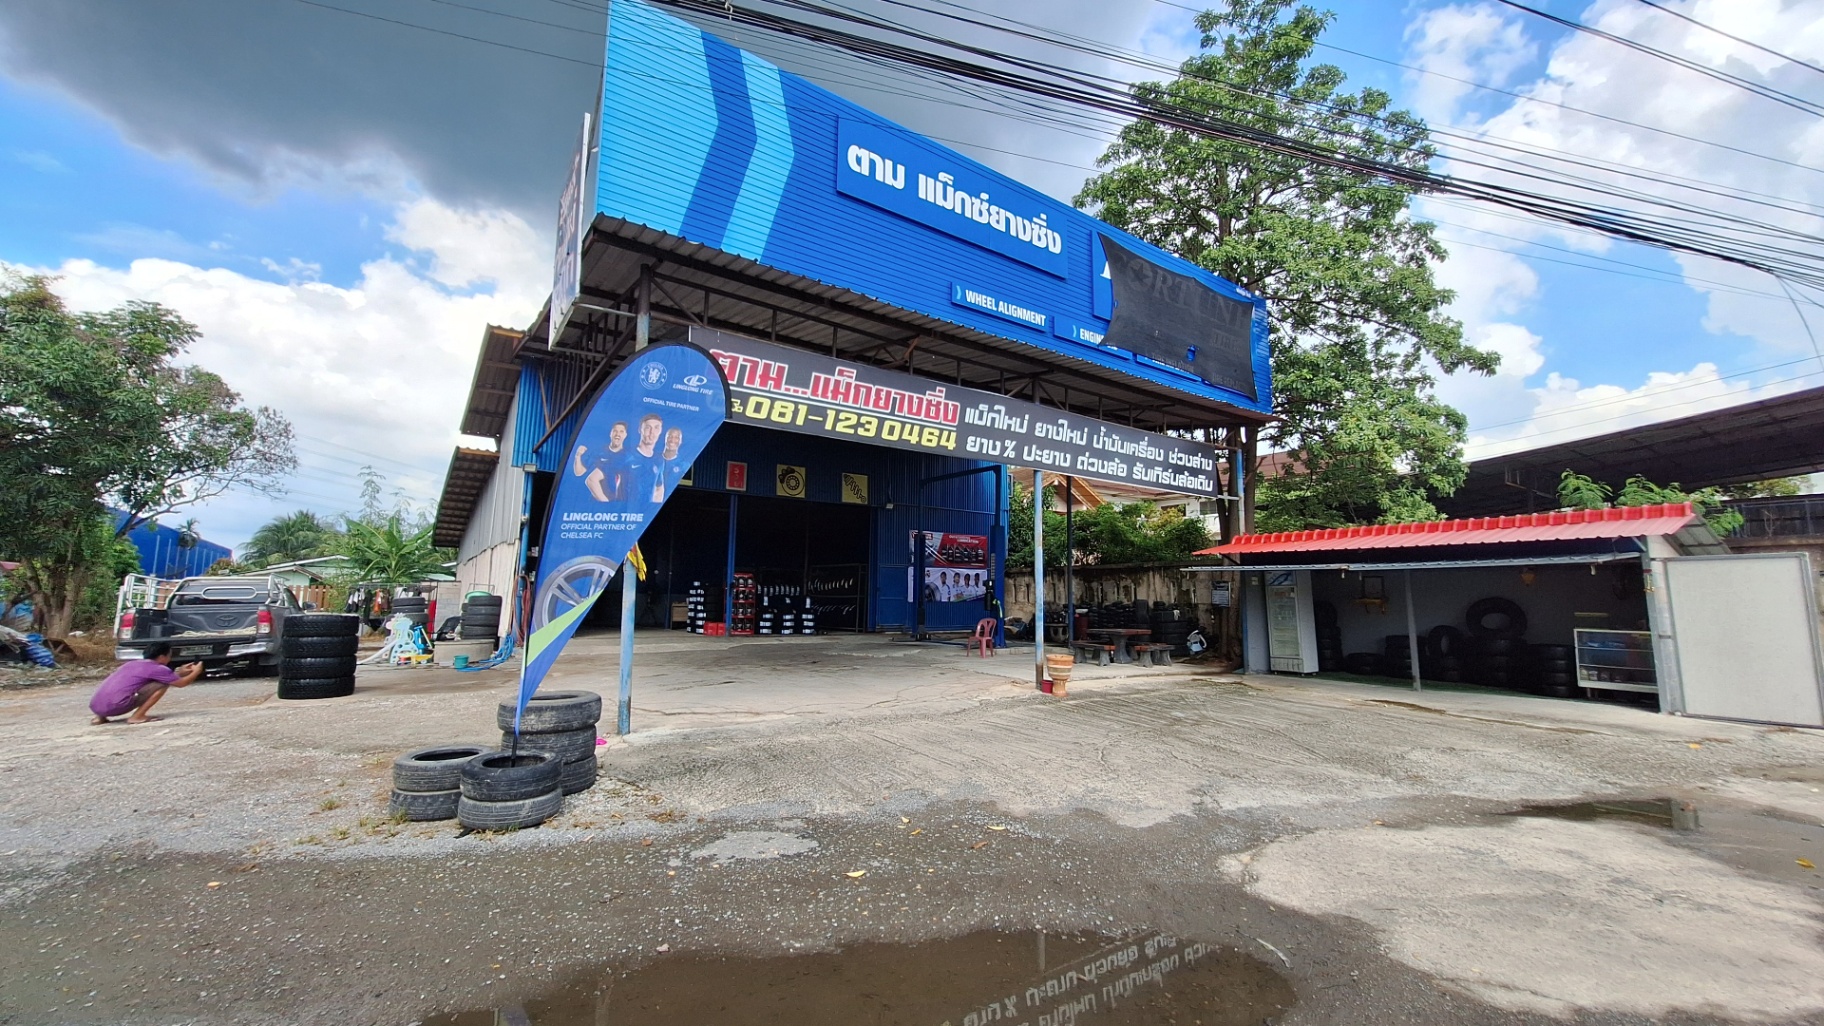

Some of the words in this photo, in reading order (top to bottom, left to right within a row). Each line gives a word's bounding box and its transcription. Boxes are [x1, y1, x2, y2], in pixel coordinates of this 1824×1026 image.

[847, 144, 906, 190] ตาม
[965, 289, 997, 312] WHEEL
[998, 301, 1046, 327] ALIGNMENT
[673, 384, 699, 393] LINGLONG
[700, 388, 714, 396] TIRE
[643, 397, 666, 406] OFFICIAL
[665, 400, 676, 408] TIRE
[677, 403, 700, 412] PARTNER
[1034, 419, 1088, 446] ยางใหม่
[1092, 426, 1164, 463] น้ำมันเครื่อง
[1168, 447, 1213, 471] ช่วงล่าง
[1022, 444, 1071, 467] ปะยาง
[1076, 451, 1127, 478] ถ่วงล้อ
[563, 513, 618, 521] LINGLONG
[620, 513, 644, 522] TIRE
[560, 523, 592, 531] OFFICIAL
[593, 523, 625, 531] PARTNER
[626, 523, 637, 531] OF
[560, 531, 592, 539] CHELSEA
